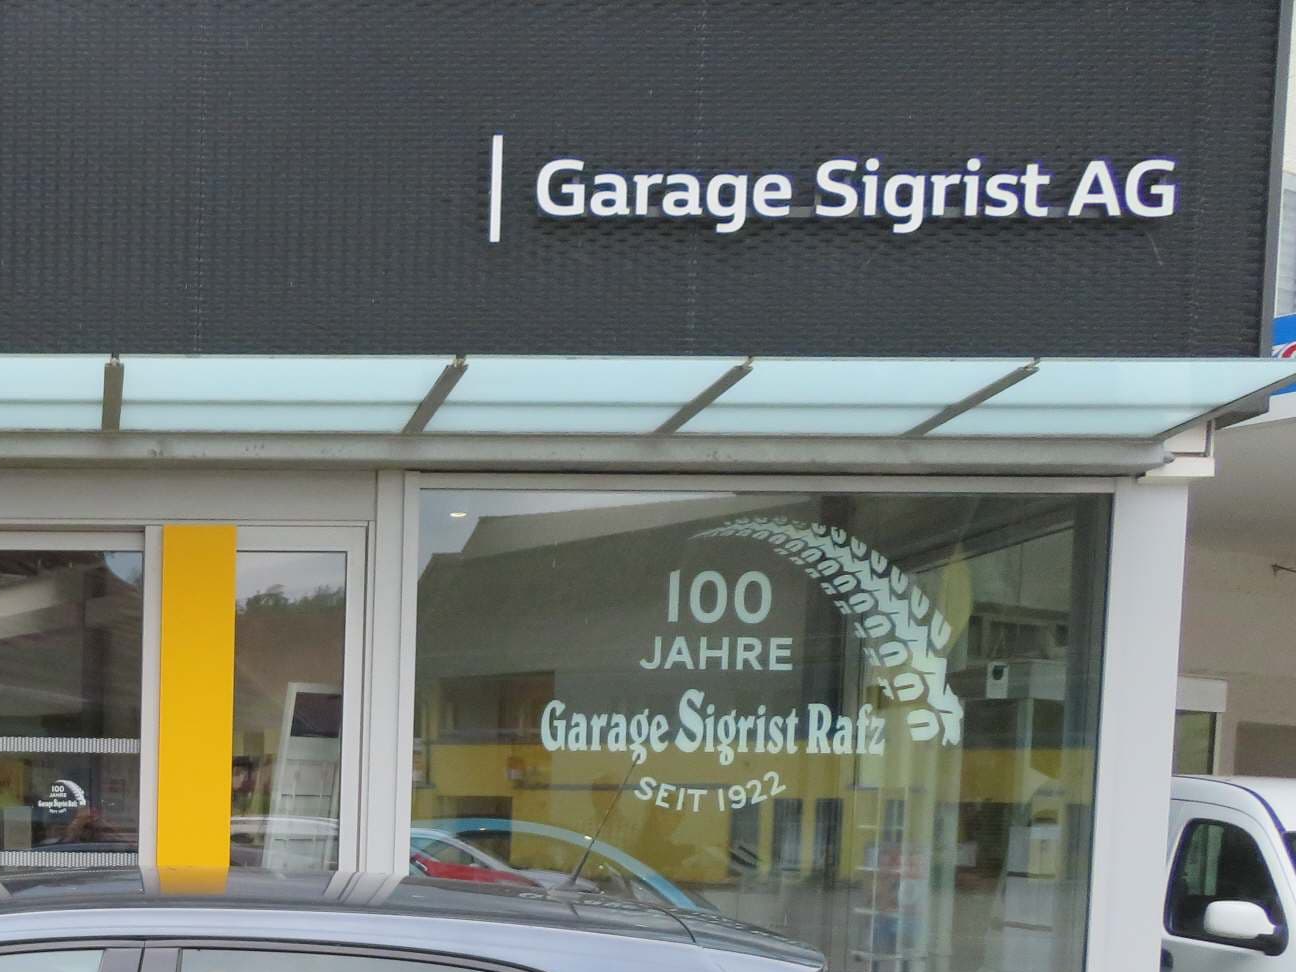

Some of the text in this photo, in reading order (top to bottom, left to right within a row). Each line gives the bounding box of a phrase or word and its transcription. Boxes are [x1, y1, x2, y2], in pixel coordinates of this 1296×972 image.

[536, 157, 1176, 234] Garage Sigrist AG
[667, 569, 772, 624] 100
[639, 636, 794, 671] JAHRE
[540, 688, 886, 766] Garage Sigrist Rafz
[634, 770, 787, 813] SEIT 1922
